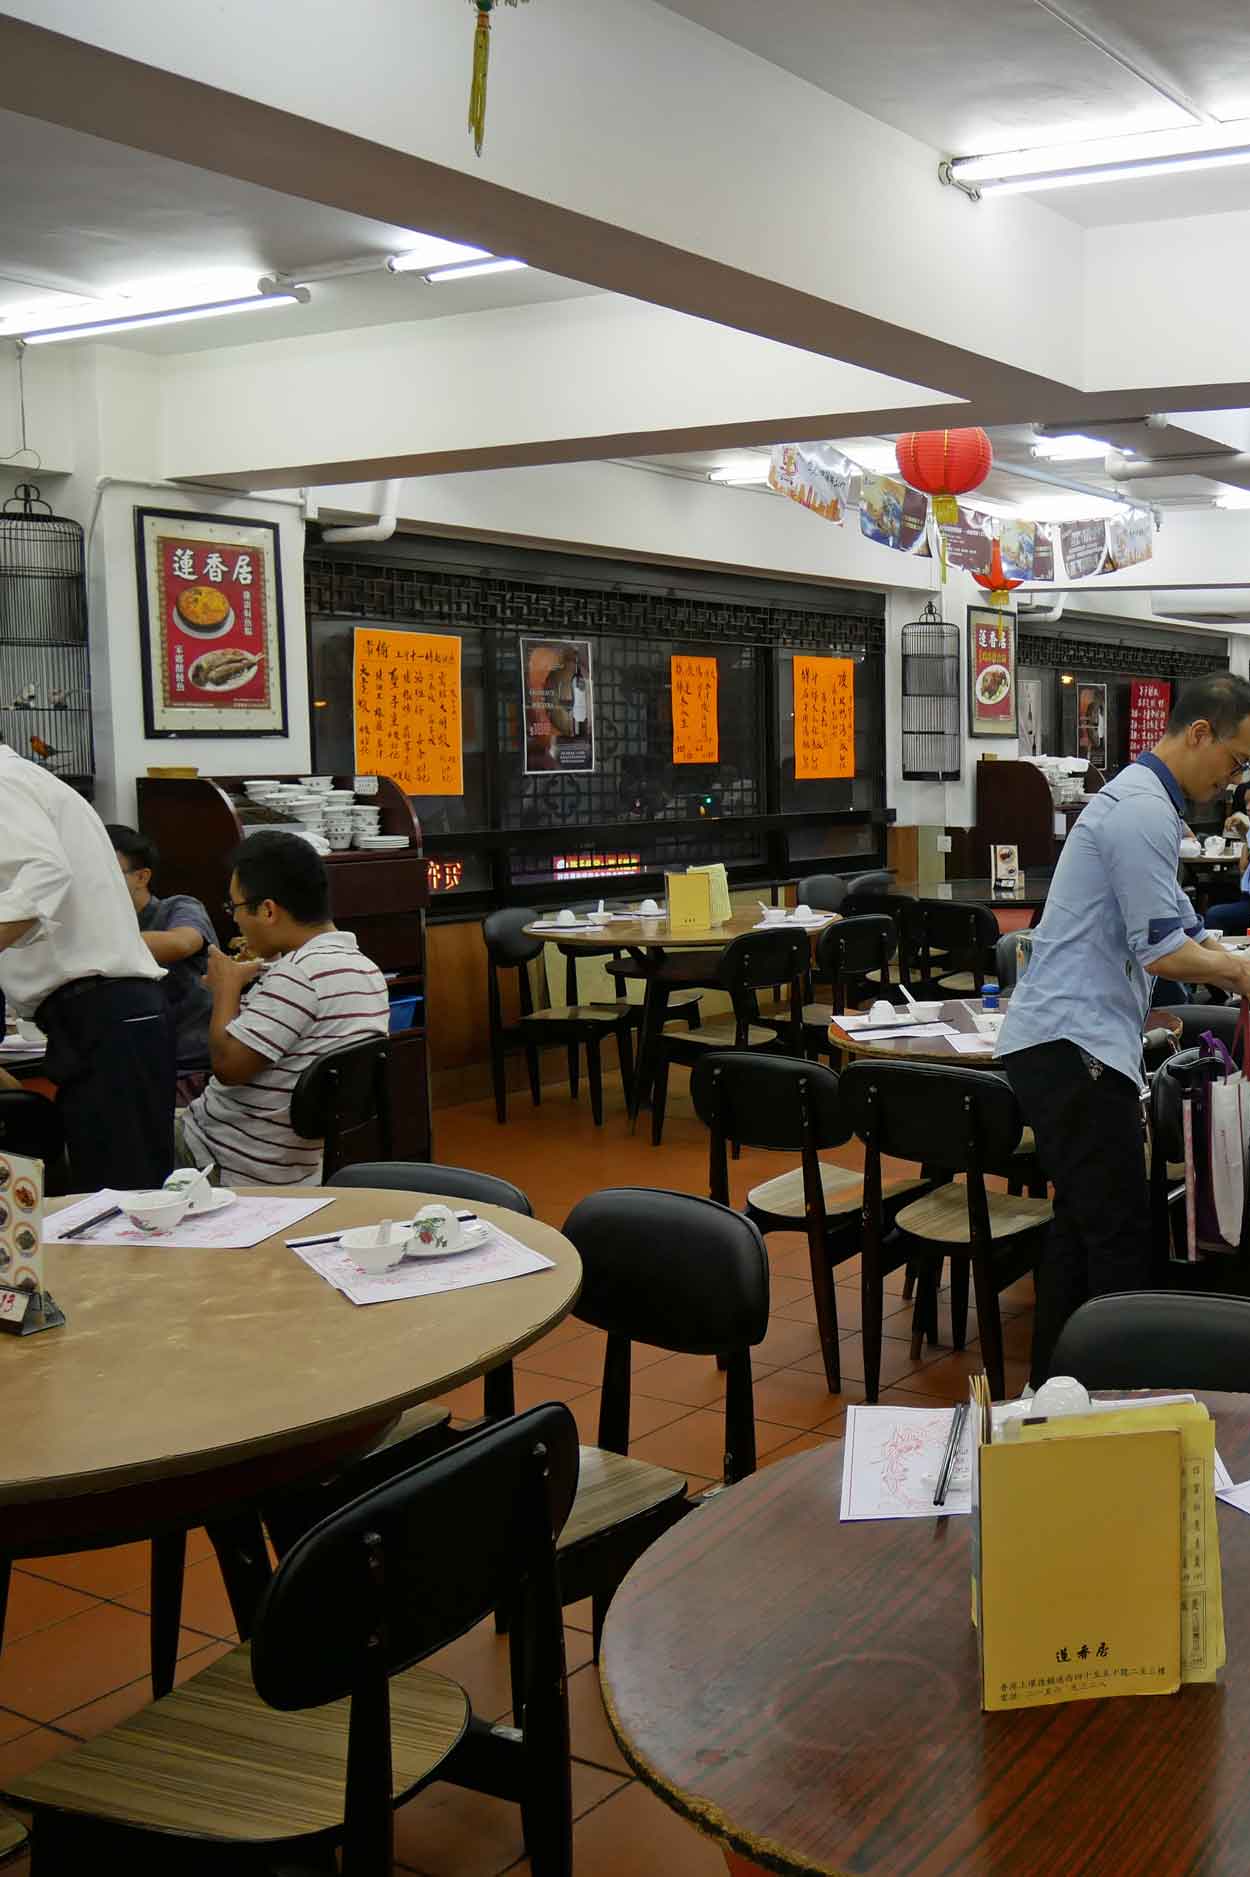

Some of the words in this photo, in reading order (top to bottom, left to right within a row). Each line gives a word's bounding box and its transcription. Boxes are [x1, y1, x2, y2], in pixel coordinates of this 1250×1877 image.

[172, 548, 254, 585] 蓮香居
[1055, 1641, 1113, 1664] 蓮香居
